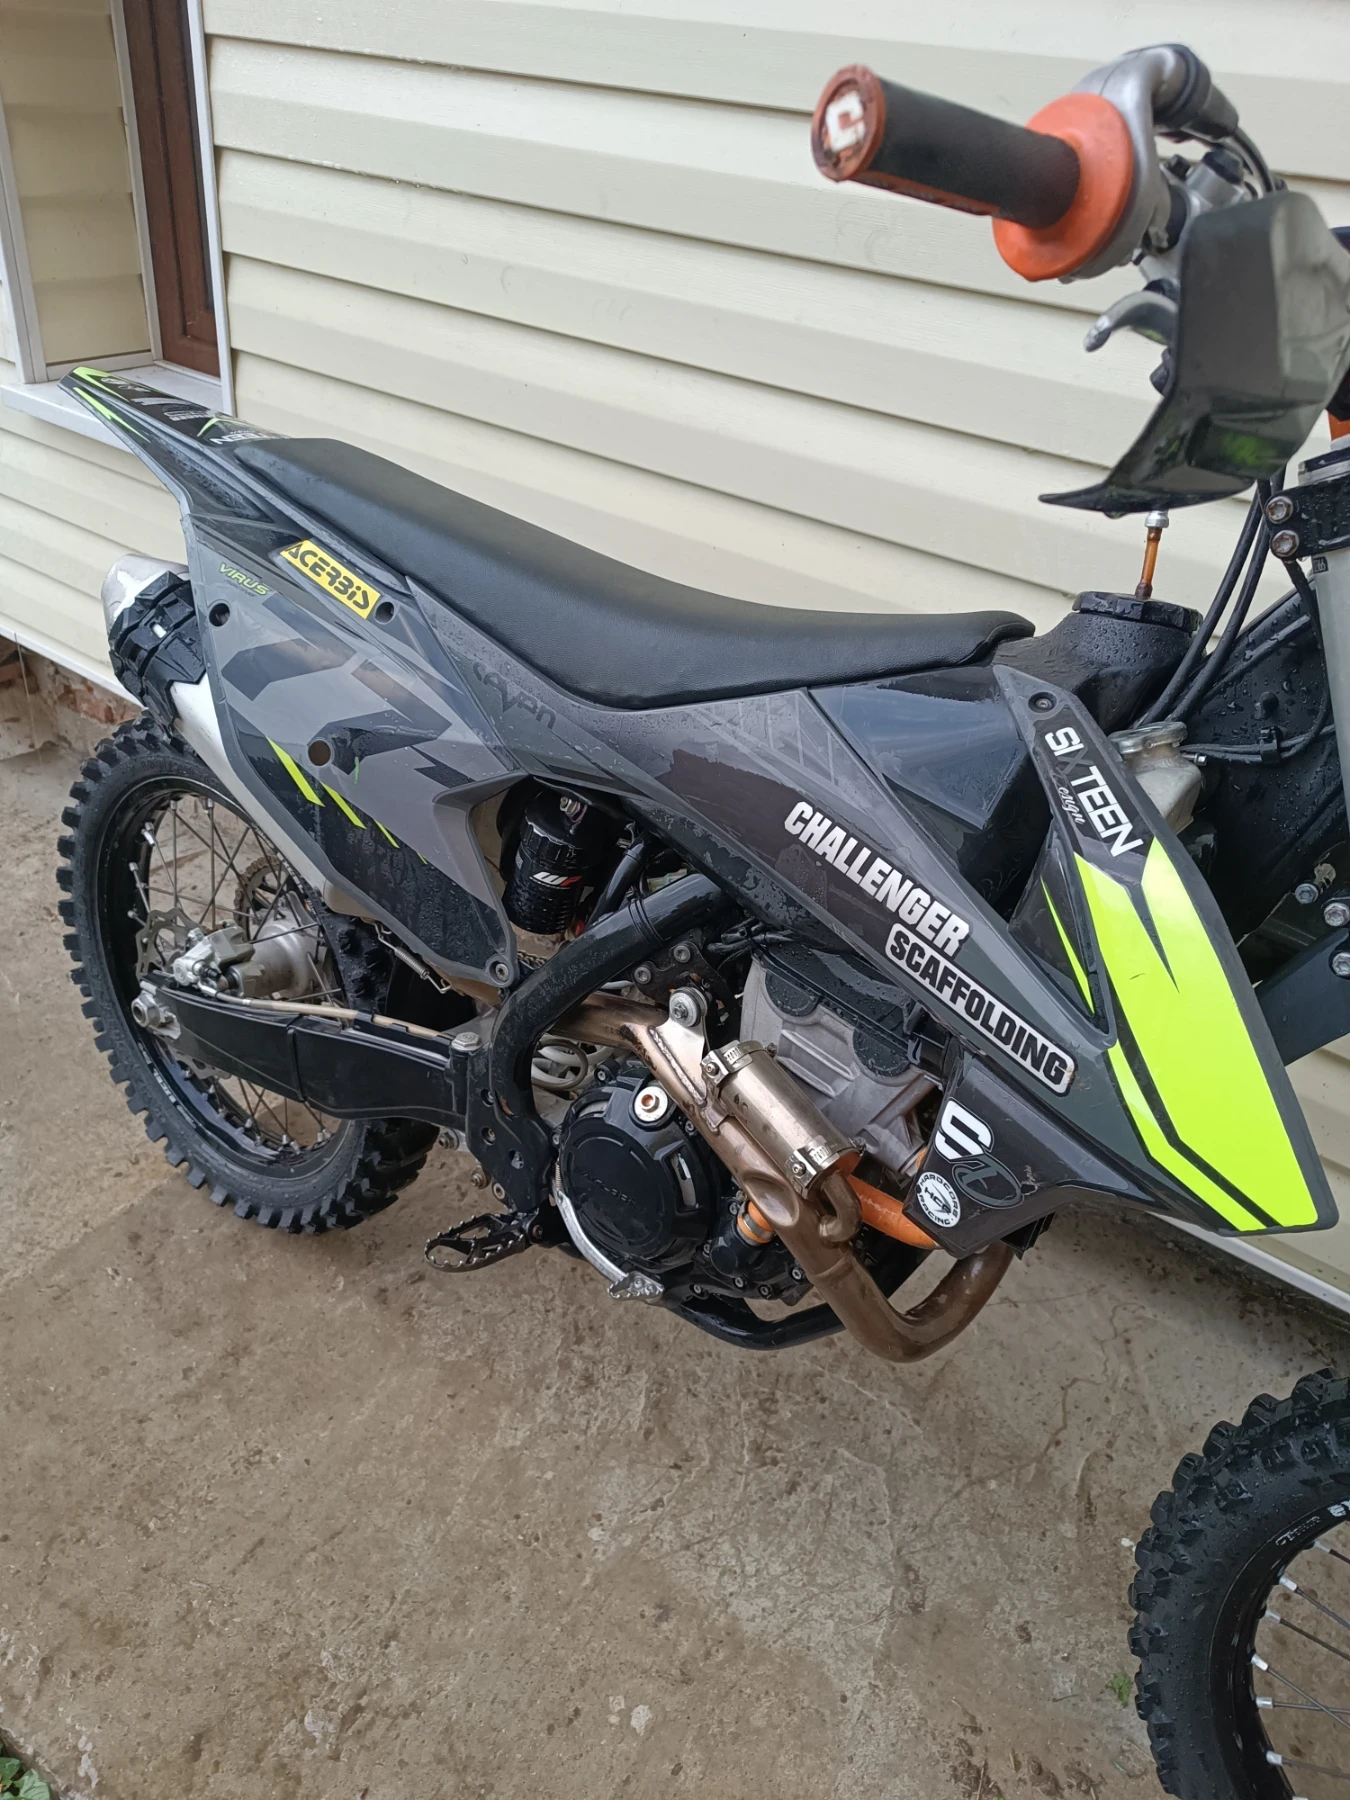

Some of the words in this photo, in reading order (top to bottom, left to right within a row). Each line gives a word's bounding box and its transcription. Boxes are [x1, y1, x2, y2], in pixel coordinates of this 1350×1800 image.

[219, 562, 269, 596] VIRUS
[286, 543, 370, 610] ACERBIS
[1044, 726, 1144, 857] SIXTEEN
[784, 801, 970, 957] CHALLENGER
[890, 931, 1068, 1086] SCAFFOLDING
[919, 1194, 950, 1225] RACING
[920, 1174, 958, 1218] HARDCORE
[924, 1187, 951, 1215] HCR
